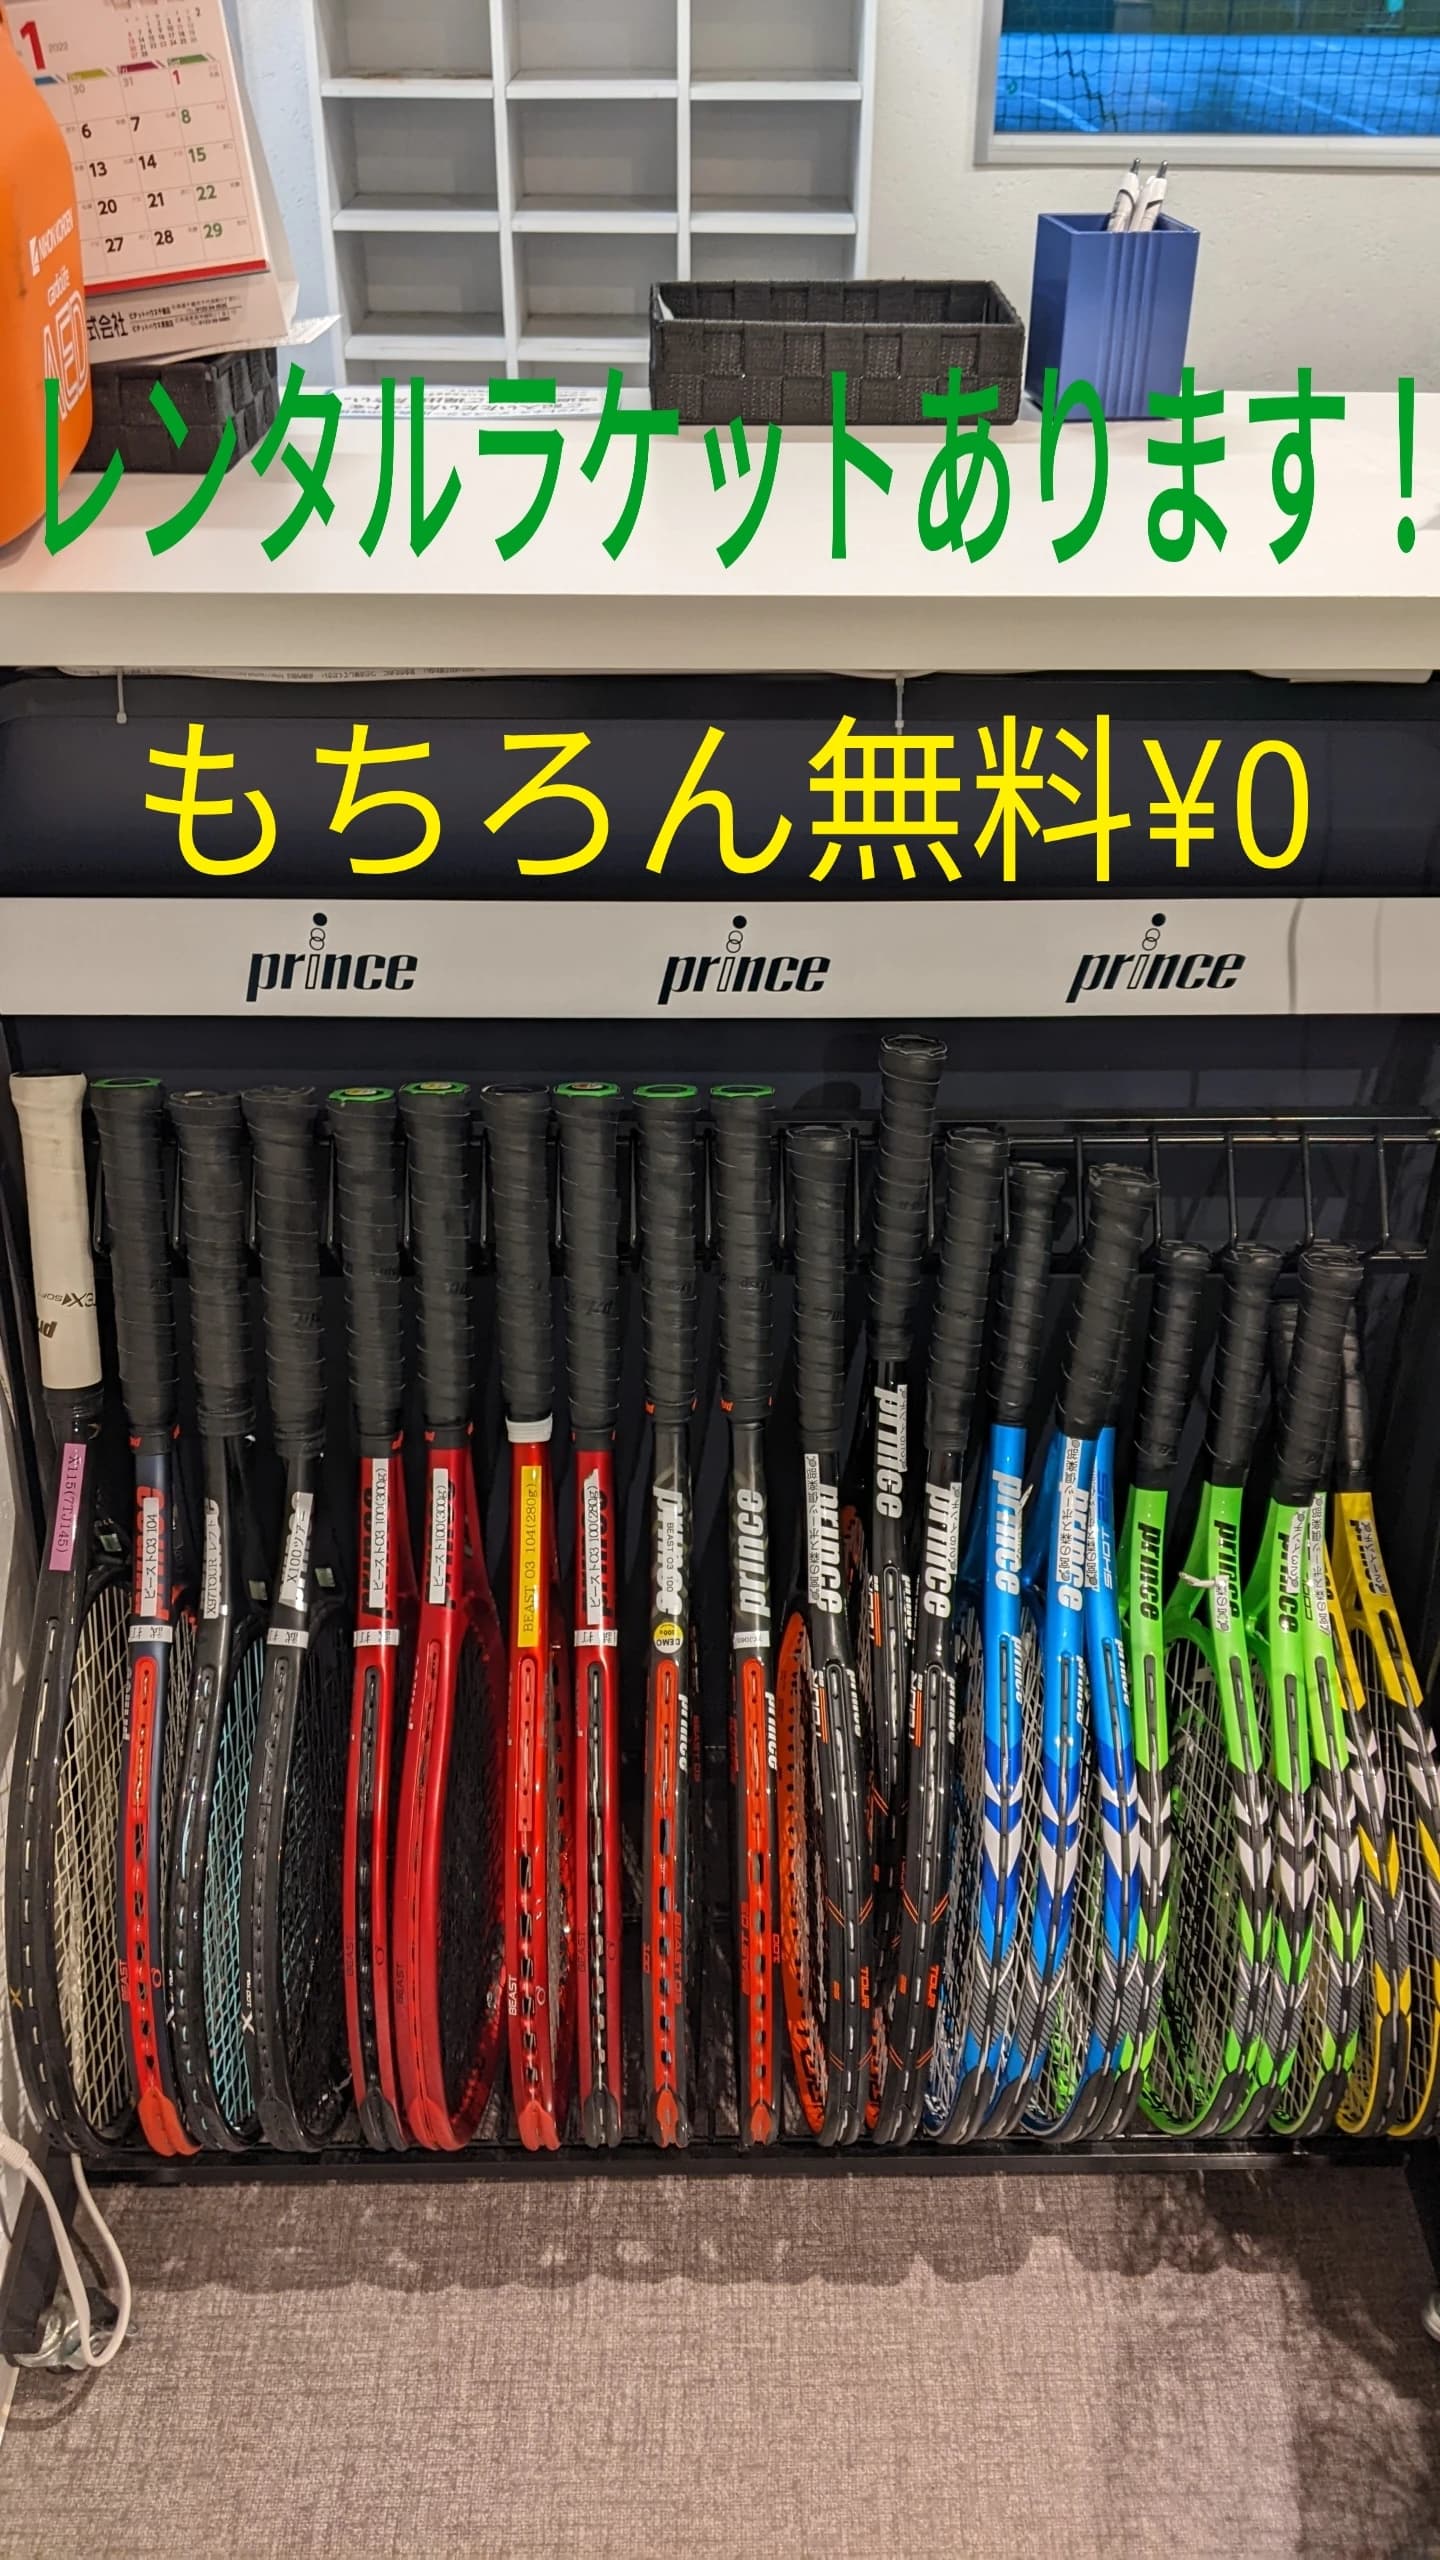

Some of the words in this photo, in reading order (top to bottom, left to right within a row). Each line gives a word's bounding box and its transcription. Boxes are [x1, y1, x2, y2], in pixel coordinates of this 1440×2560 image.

[20, 20, 46, 70] 1
[72, 84, 86, 95] 30
[122, 77, 134, 88] 31
[172, 70, 181, 85] 1
[81, 123, 92, 139] 6
[130, 116, 140, 132] 7
[180, 109, 191, 124] 8
[89, 161, 107, 178] 13
[138, 154, 157, 171] 14
[188, 147, 207, 163] 15
[97, 199, 117, 216] 20
[147, 192, 165, 208] 21
[196, 185, 216, 201] 22
[105, 237, 124, 253] 27
[154, 230, 174, 246] 28
[203, 223, 223, 239] 29
[43, 290, 88, 420] AED
[247, 912, 418, 1002] prince
[658, 915, 831, 1005] prince
[1066, 912, 1246, 1004] prince
[874, 1385, 903, 1519] prince
[145, 1513, 156, 1533] 104
[523, 1482, 537, 1553] 104(280g)
[666, 1522, 674, 1552] BEAST
[992, 1470, 1023, 1597] prince
[285, 1510, 307, 1584] X100ツアー
[736, 1488, 771, 1618] prince
[816, 1482, 843, 1615] prince
[925, 1482, 954, 1619] prince
[1102, 1527, 1114, 1590] SHOT
[666, 1575, 674, 1593] 100
[1138, 1521, 1164, 1622] prince
[523, 1584, 535, 1632] BEAST
[656, 1638, 681, 1646] DEMO
[119, 1959, 131, 2002] BEAST
[508, 1974, 517, 2016] BEAST
[860, 1966, 870, 2009] TOUR
[926, 1965, 940, 2009] TOUR
[240, 2010, 255, 2035] X
